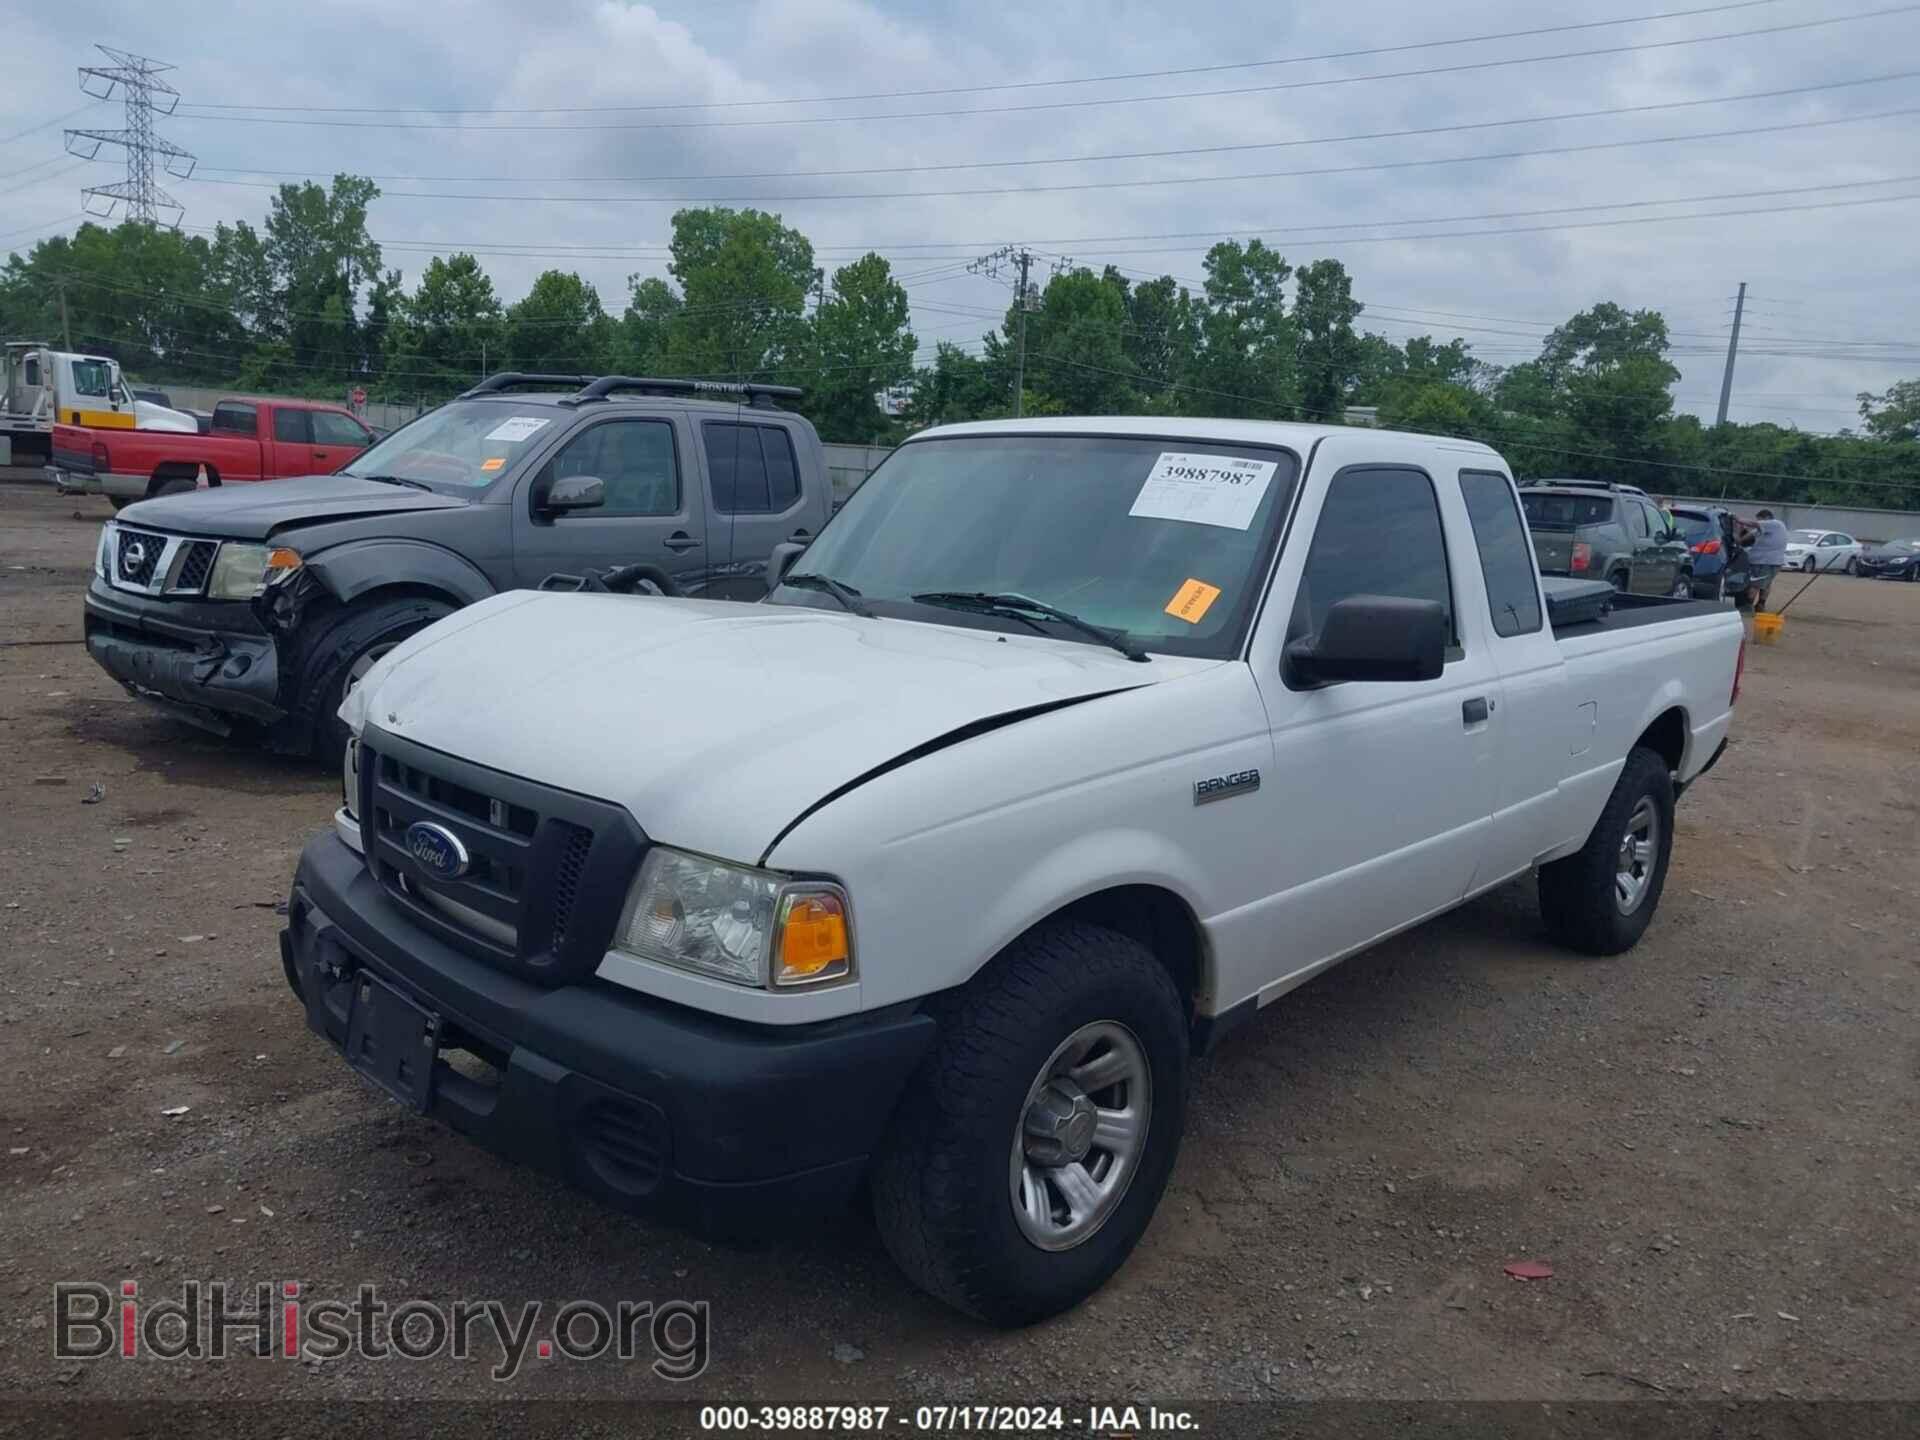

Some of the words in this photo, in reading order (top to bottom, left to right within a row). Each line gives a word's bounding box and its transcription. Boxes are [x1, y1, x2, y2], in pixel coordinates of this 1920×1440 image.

[1160, 465, 1256, 487] 39887987
[1196, 768, 1260, 794] RANGER
[413, 830, 448, 868] Ford
